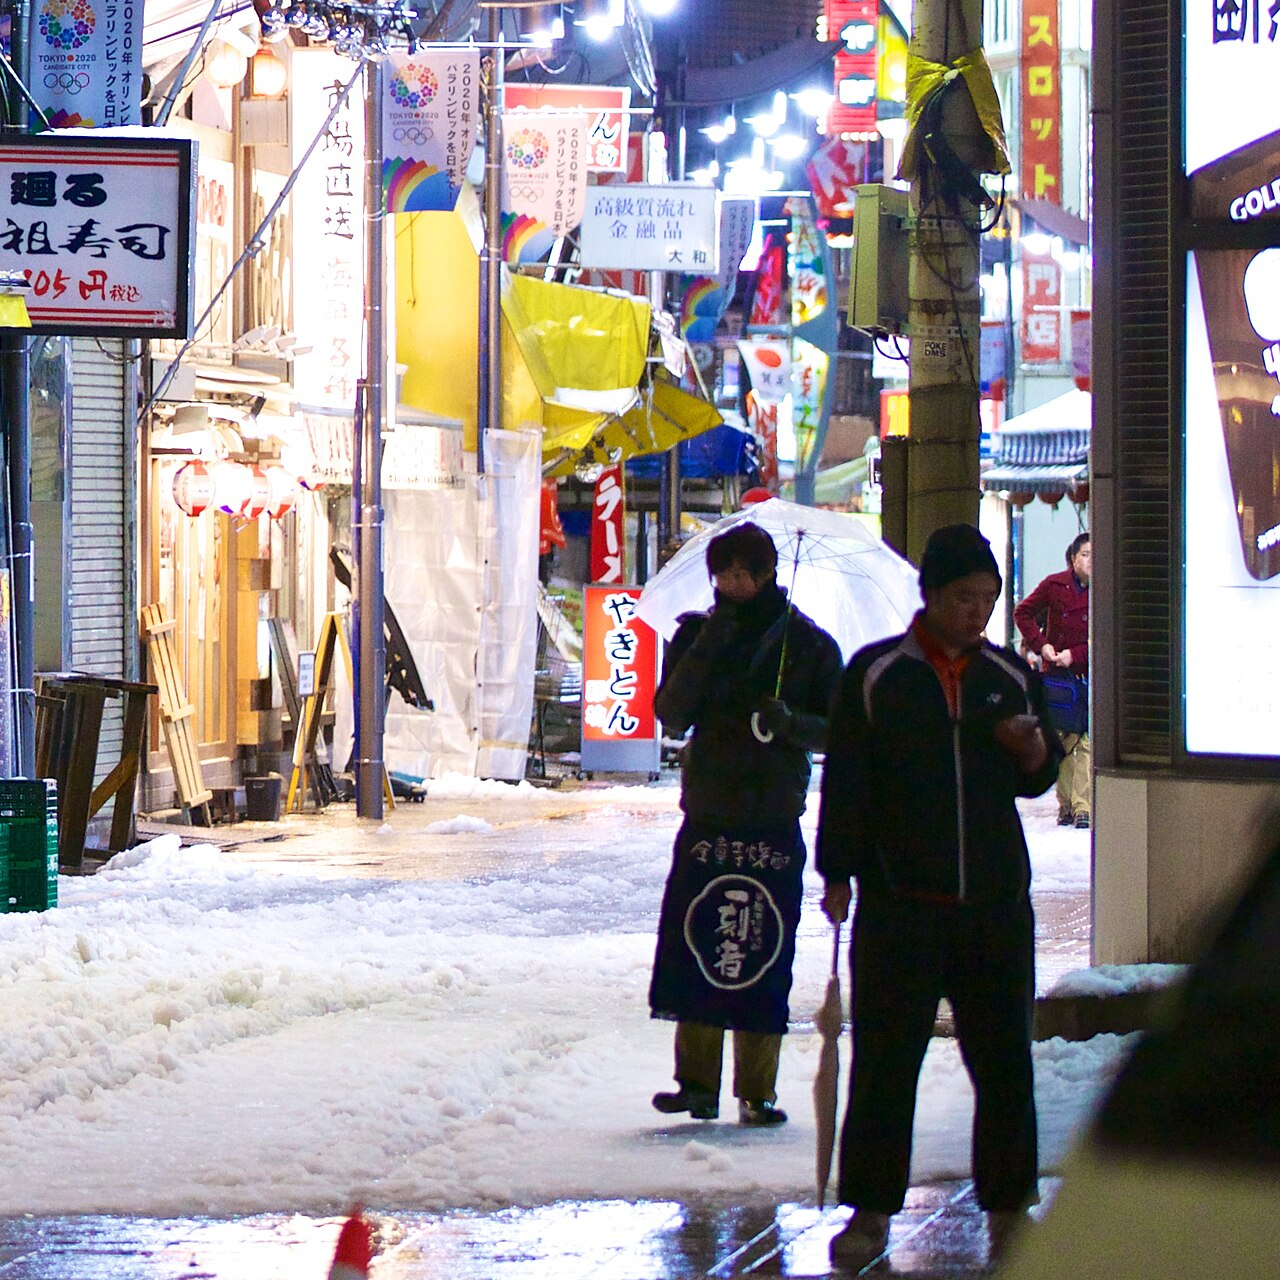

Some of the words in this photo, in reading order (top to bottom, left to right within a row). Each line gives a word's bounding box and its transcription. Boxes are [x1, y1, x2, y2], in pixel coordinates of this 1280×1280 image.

[38, 54, 66, 62] TOKYO
[75, 54, 96, 62] 2020
[460, 63, 471, 123] 2020年
[10, 170, 108, 208] 廻る
[594, 196, 696, 218] 高級質流れ
[610, 218, 682, 240] 金融品
[668, 249, 707, 265] 大和
[602, 593, 640, 736] やきとん
